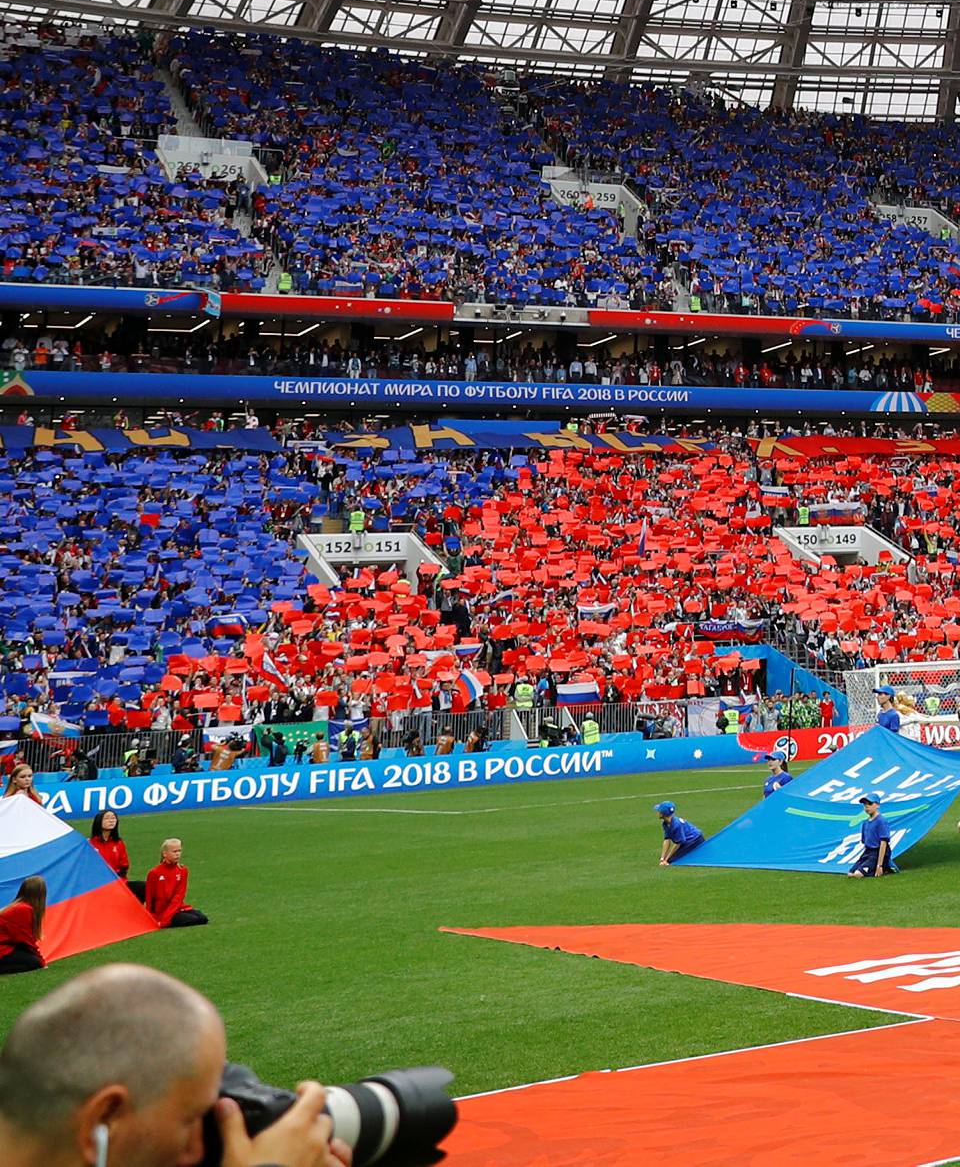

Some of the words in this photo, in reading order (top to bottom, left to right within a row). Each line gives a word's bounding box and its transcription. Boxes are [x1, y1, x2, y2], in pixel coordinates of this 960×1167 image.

[221, 164, 243, 176] 261
[560, 189, 580, 200] 260
[596, 192, 616, 203] 259
[911, 216, 928, 225] 257
[274, 380, 380, 396] ЧЕМПИОНАТ
[384, 383, 433, 397] МИРА
[437, 384, 460, 398] ПО
[464, 384, 538, 400] ФУТБОЛУ
[542, 386, 574, 400] FIFA
[577, 387, 611, 401] 2018
[615, 388, 625, 401] В
[797, 534, 818, 545] 150
[835, 533, 857, 544] 149
[325, 541, 351, 553] 152
[375, 541, 401, 552] 151
[817, 730, 865, 754] 201
[82, 784, 133, 812] ПО
[143, 771, 301, 806] ФУТБОЛУ
[309, 767, 375, 794] FIFA
[382, 759, 451, 789] 2018
[458, 759, 478, 783] В
